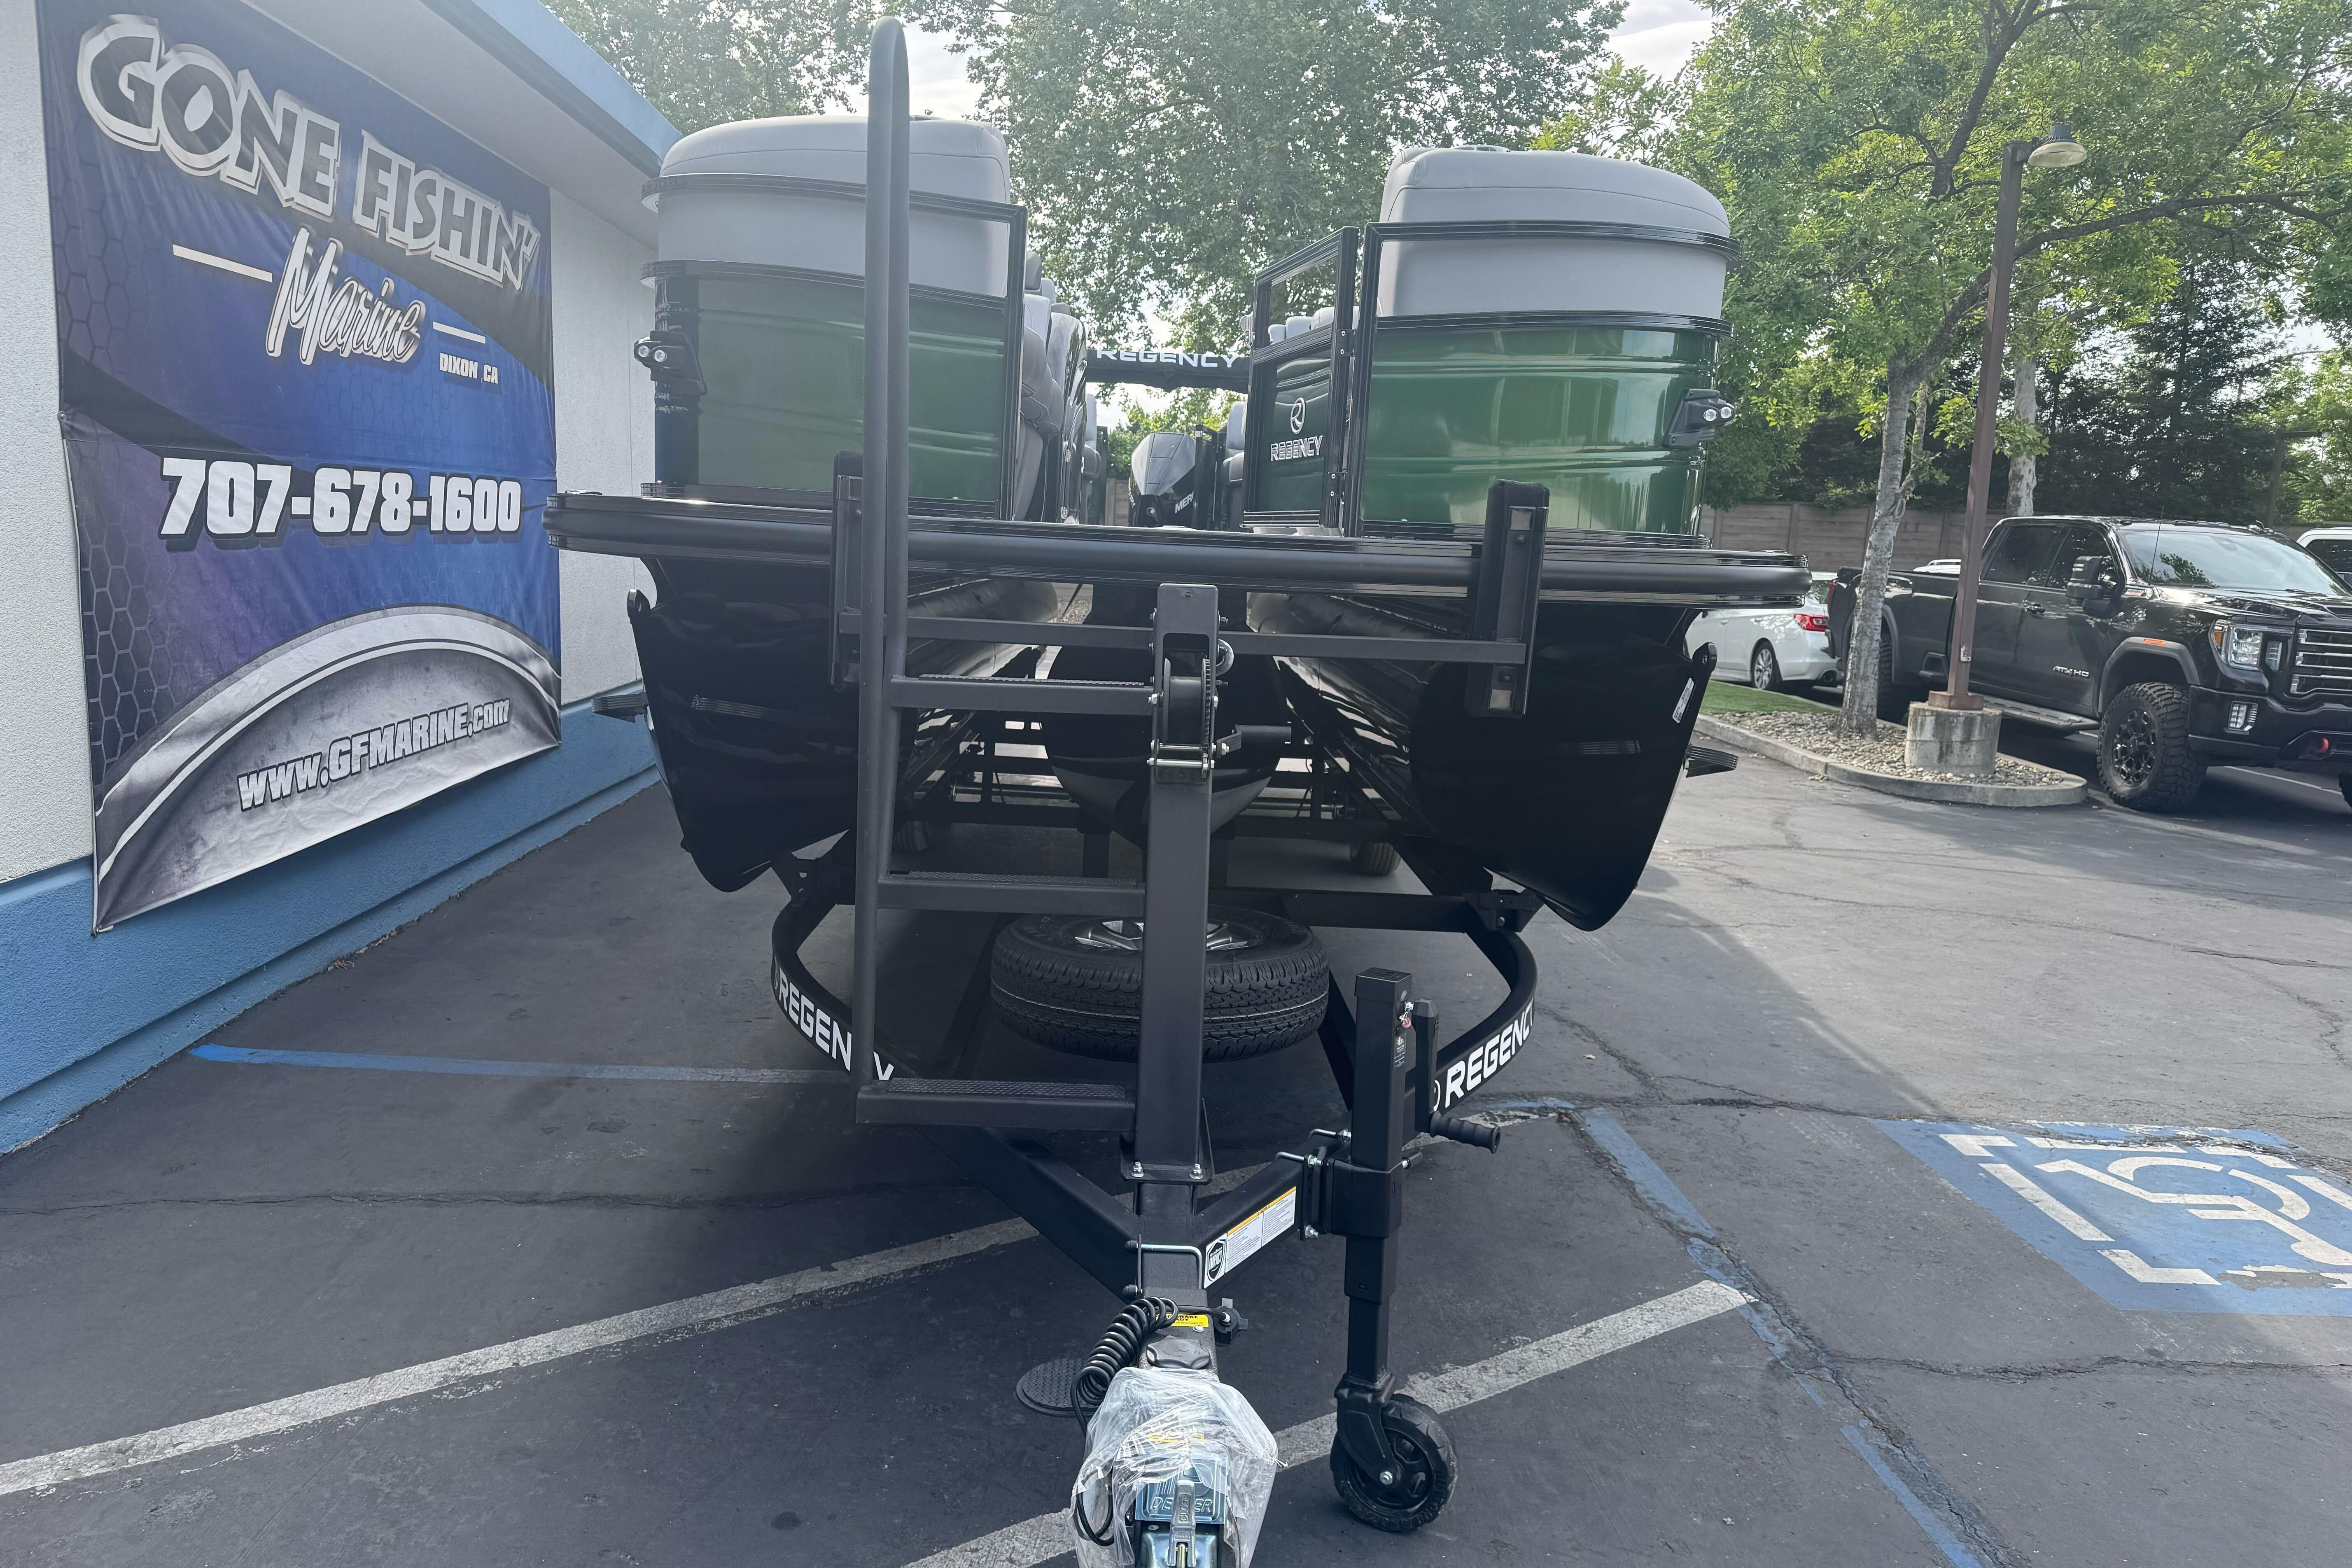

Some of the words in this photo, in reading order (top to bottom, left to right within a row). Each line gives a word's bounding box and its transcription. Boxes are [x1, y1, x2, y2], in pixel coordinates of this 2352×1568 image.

[77, 14, 340, 222] GONE
[352, 130, 541, 290] FISHIN'
[266, 224, 426, 365] Marine
[1096, 349, 1239, 368] REGENCY
[1271, 435, 1323, 462] REGENCY
[160, 457, 522, 536] 707-678-1600
[779, 966, 894, 1080] REGENY
[1150, 1496, 1213, 1513] DEER
